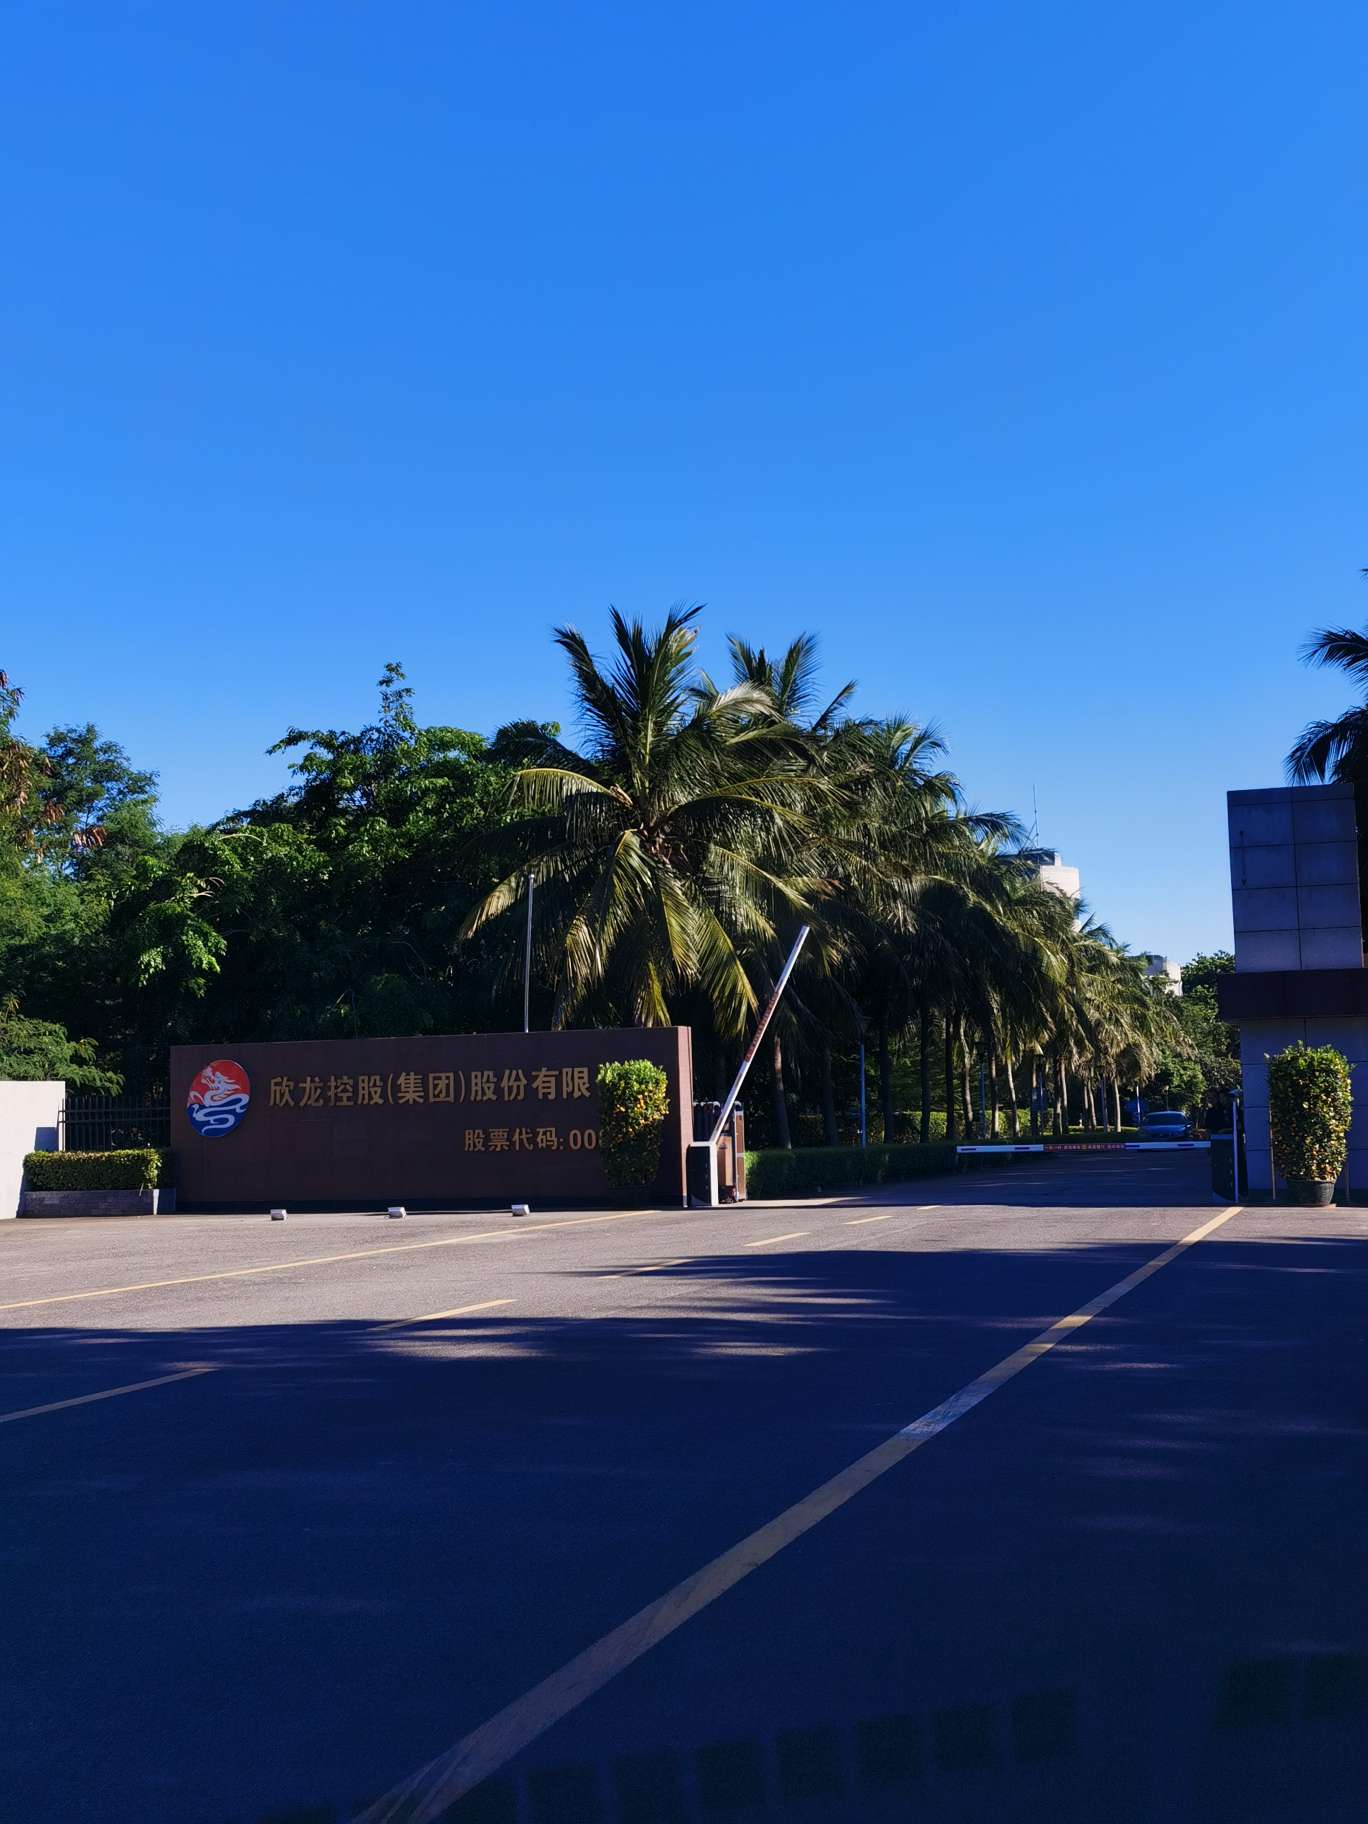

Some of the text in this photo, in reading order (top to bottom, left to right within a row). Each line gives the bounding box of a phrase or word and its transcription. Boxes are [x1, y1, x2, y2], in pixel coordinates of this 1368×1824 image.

[269, 1067, 591, 1107] 欣龙控股(集团)股份有限
